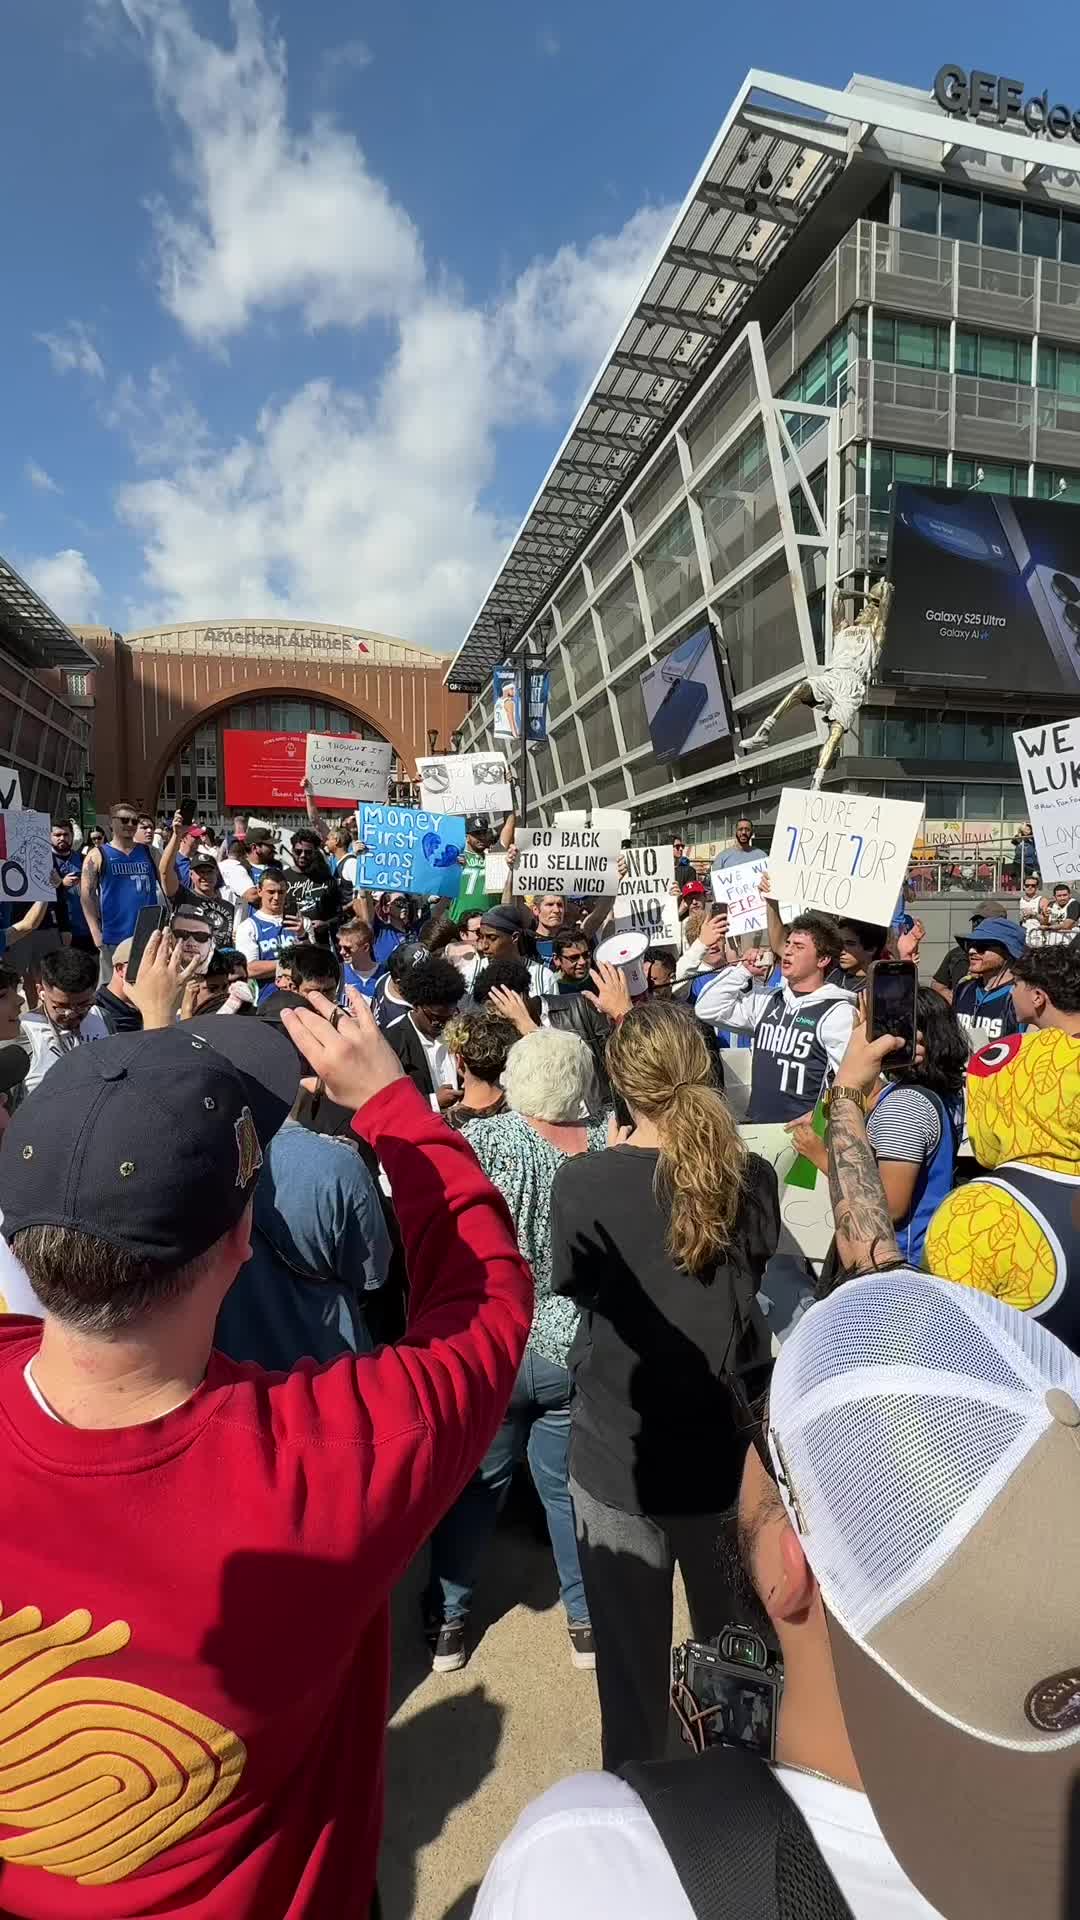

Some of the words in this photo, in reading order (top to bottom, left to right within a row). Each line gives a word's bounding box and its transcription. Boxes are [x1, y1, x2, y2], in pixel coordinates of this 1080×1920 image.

[925, 610, 962, 625] Galaxy
[964, 613, 981, 625] S25
[983, 615, 1007, 627] Ultra
[204, 629, 286, 648] American
[287, 632, 352, 650] Airlines
[939, 627, 970, 640] Galaxy
[328, 742, 367, 752] THOUGHT
[1018, 724, 1075, 758] WE
[311, 776, 355, 789] COWBOYS
[364, 804, 443, 832] Money
[863, 804, 881, 833] A
[363, 825, 419, 849] First
[532, 831, 553, 847] GO
[561, 832, 600, 848] BACK
[926, 832, 960, 845] URBAN
[360, 846, 414, 869] Fans
[523, 853, 538, 869] TO
[547, 855, 608, 872] SELLING
[626, 848, 658, 878] NO
[359, 868, 415, 890] Last
[518, 876, 564, 892] SHOES
[573, 878, 605, 893] NICO
[717, 870, 743, 885] WE
[794, 870, 853, 910] NICO
[630, 898, 663, 927] NO
[757, 1022, 815, 1059] MAVS
[777, 1058, 805, 1096] 77
